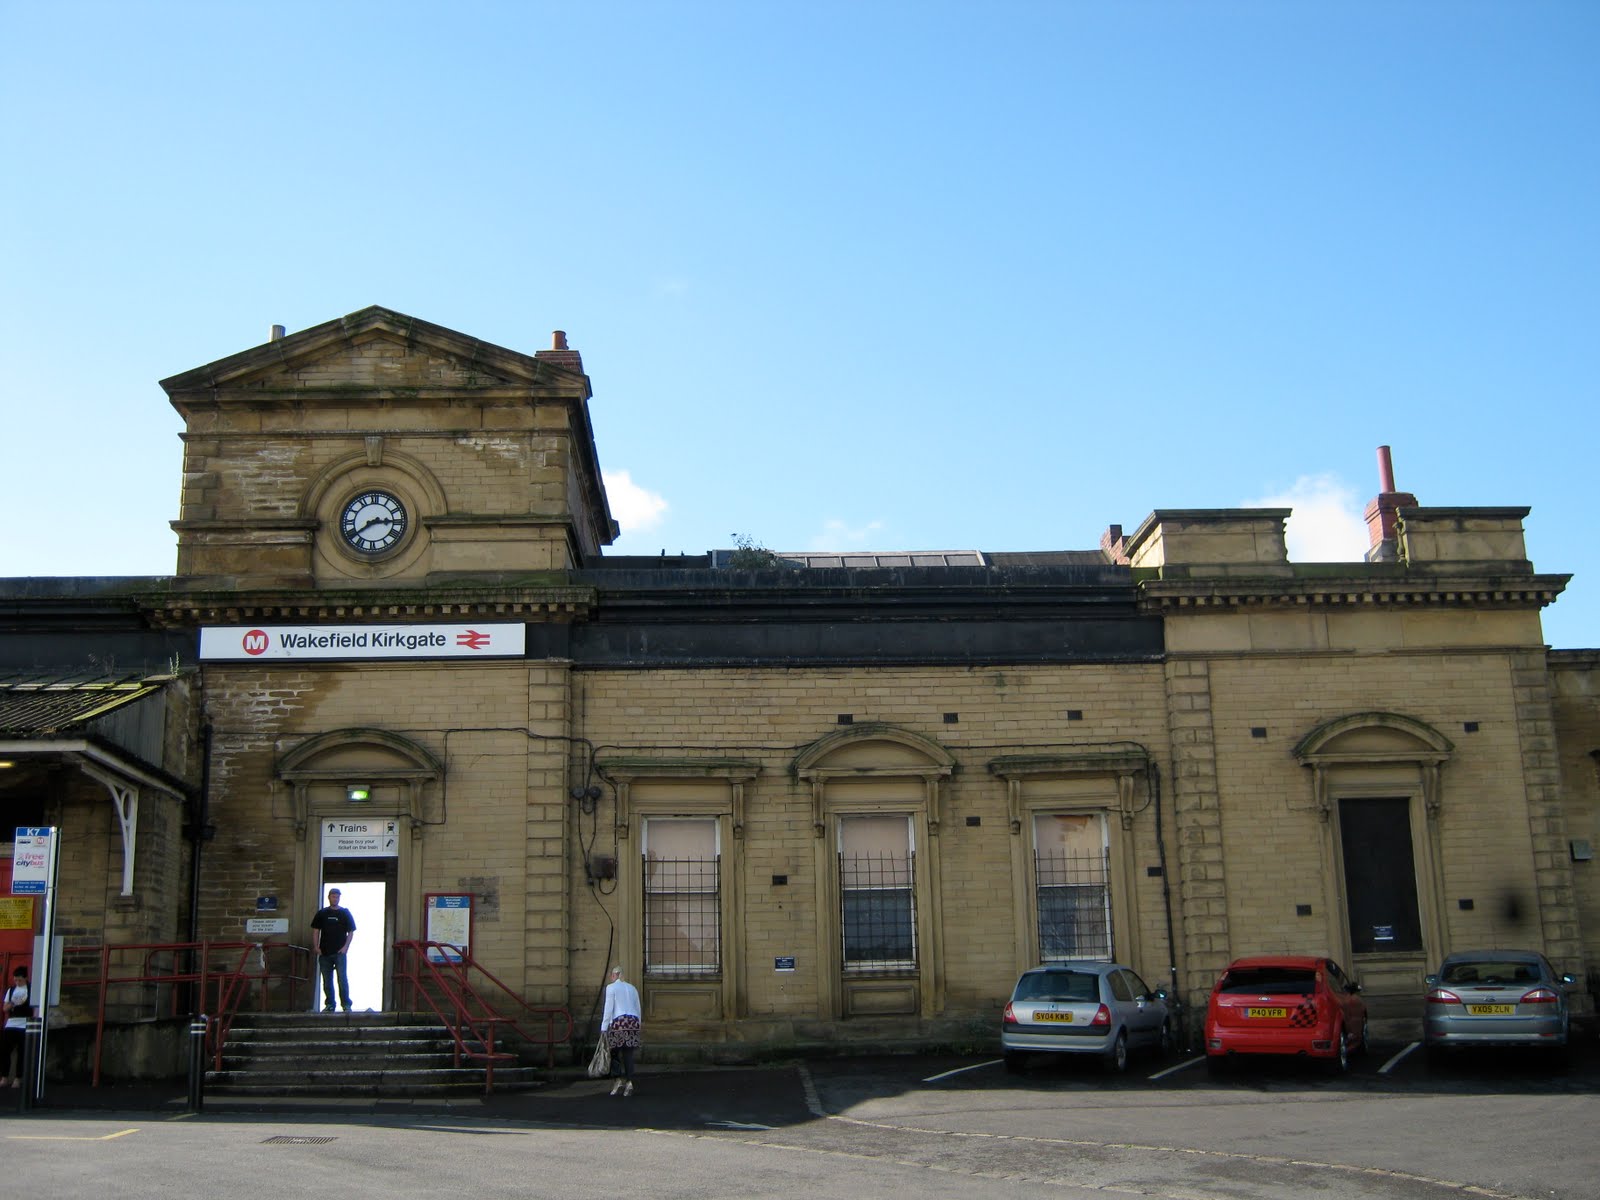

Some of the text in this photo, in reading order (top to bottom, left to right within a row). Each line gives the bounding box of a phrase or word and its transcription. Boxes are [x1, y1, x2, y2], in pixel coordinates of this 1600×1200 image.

[280, 633, 368, 650] Wakefield
[372, 631, 447, 651] Kirkgate
[26, 828, 40, 836] K7
[339, 823, 368, 833] Trains
[1494, 1005, 1510, 1014] ZLN
[1036, 1012, 1070, 1021] SV04 KWS
